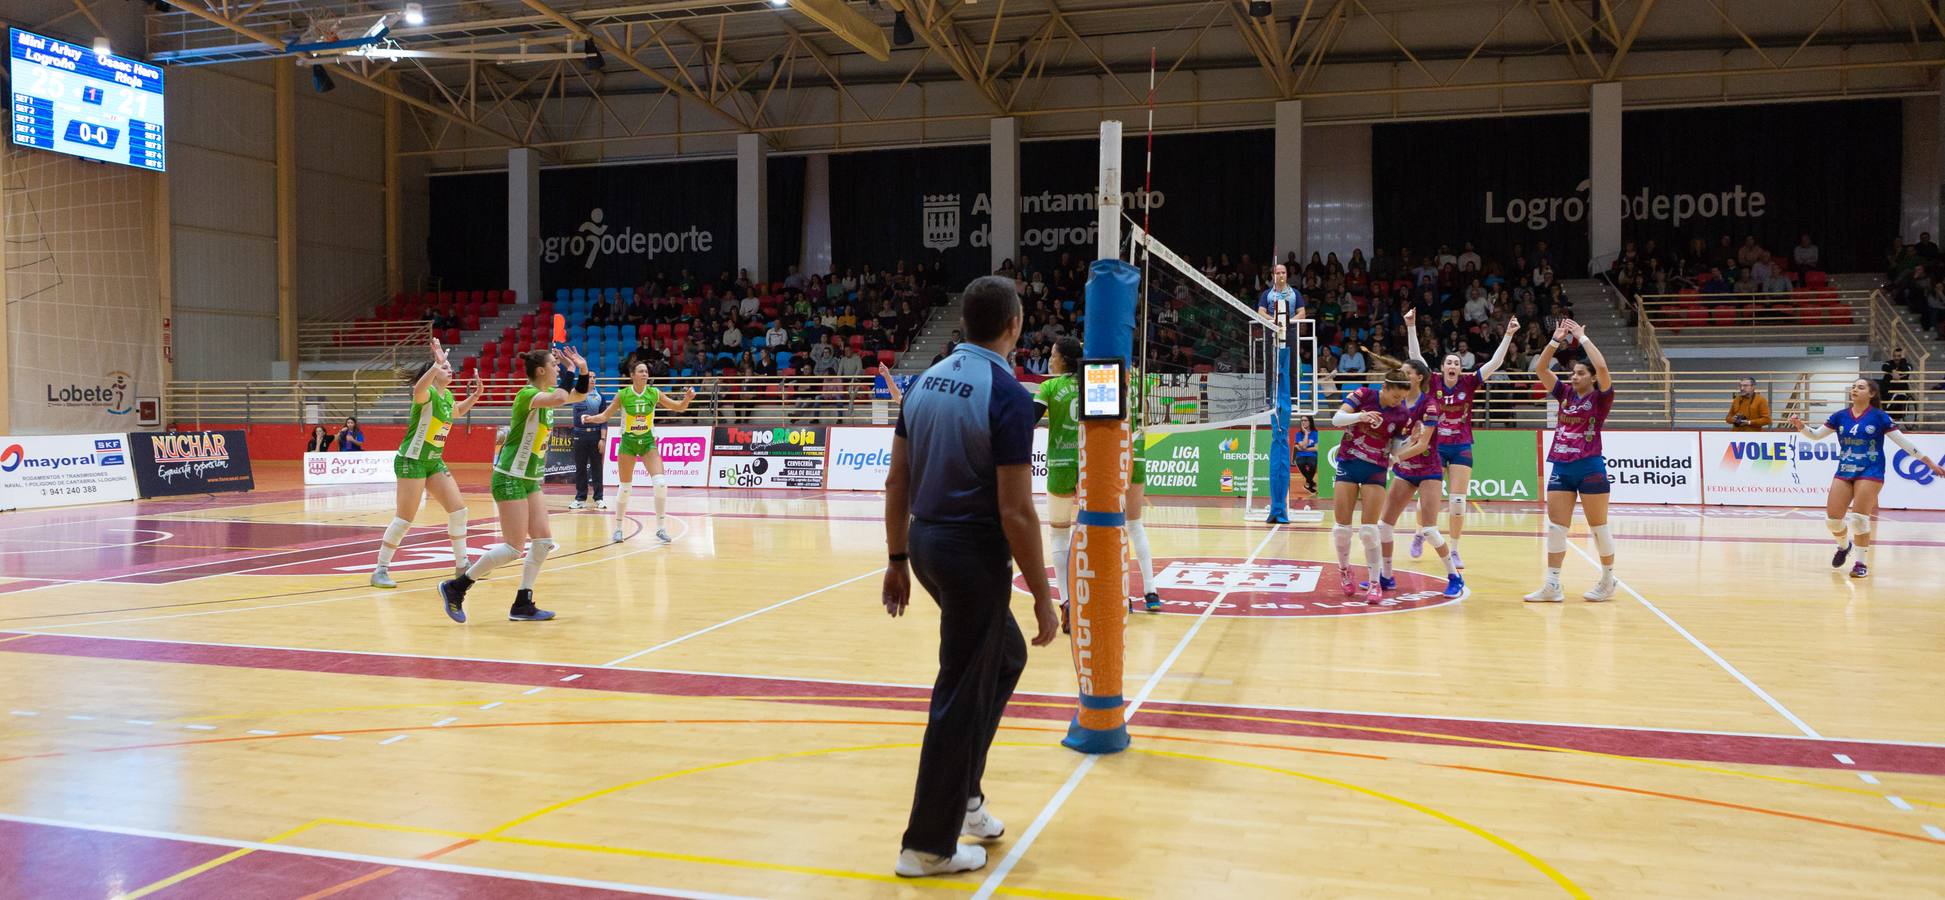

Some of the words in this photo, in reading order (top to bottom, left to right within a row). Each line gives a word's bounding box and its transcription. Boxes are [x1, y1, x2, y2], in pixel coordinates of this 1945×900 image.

[79, 123, 108, 145] 0-0
[971, 185, 1165, 216] Antaminto
[970, 224, 991, 248] d
[1020, 221, 1104, 251] ogroñ
[48, 384, 113, 402] Lobete
[922, 376, 974, 398] RFEVB
[1849, 424, 1859, 435] 4
[551, 436, 572, 447] HERAS
[728, 428, 815, 446] TecnoRioja
[97, 441, 119, 449] SKF
[1172, 446, 1200, 459] LIGA
[24, 454, 95, 469] mayoral
[544, 464, 559, 472] rueba
[1145, 460, 1200, 473] ERDROLA
[1146, 474, 1197, 487] VOLEIBOL
[1620, 472, 1640, 484] La
[1644, 472, 1687, 487] Rioja
[66, 487, 81, 495] 240
